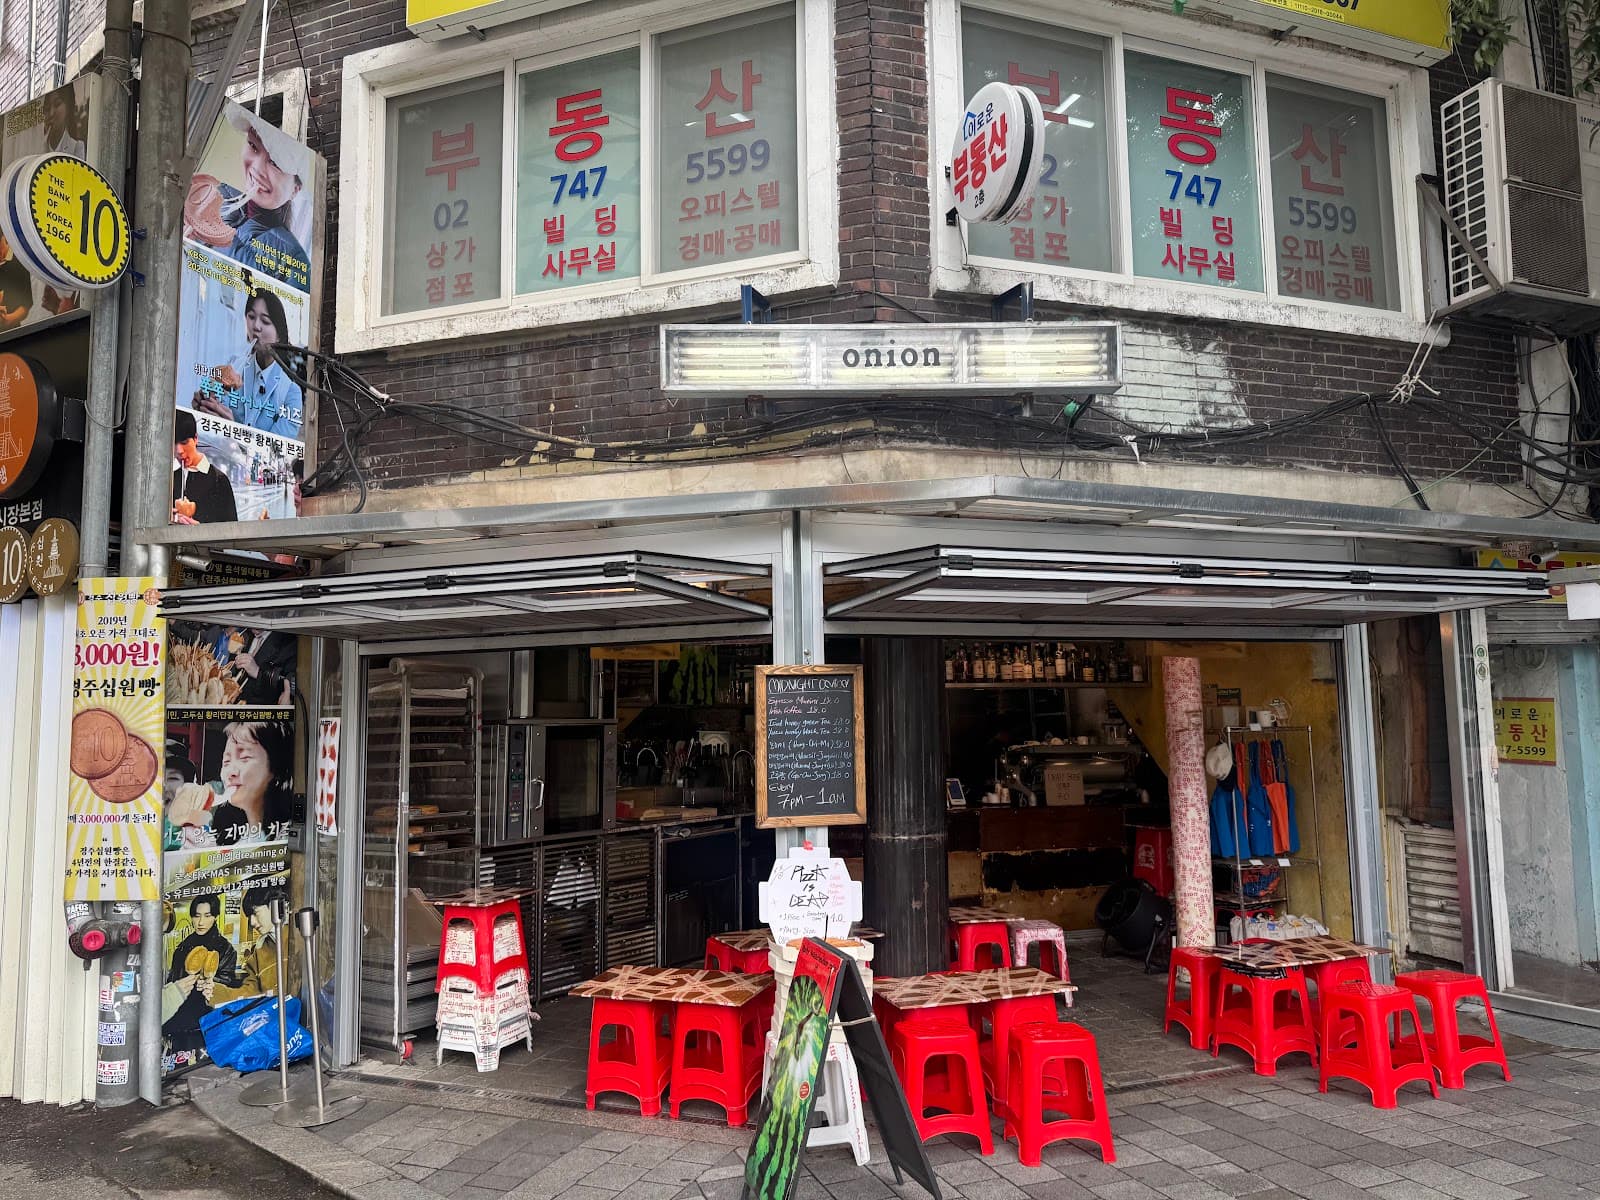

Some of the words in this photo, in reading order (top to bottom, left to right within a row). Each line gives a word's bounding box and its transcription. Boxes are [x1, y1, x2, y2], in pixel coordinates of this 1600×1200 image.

[425, 121, 480, 191] 부
[549, 88, 609, 162] 동
[695, 60, 761, 137] 산
[968, 102, 994, 137] 이로운
[1160, 87, 1221, 166] 동
[1290, 124, 1347, 197] 산
[953, 112, 1008, 202] 부동산
[48, 174, 65, 189] THE
[433, 200, 468, 230] 02
[550, 166, 607, 206] 747
[686, 139, 770, 184] 5599
[47, 198, 58, 208] OF
[48, 186, 71, 203] BANK
[974, 189, 985, 208] 2층
[1165, 169, 1221, 207] 747
[1289, 197, 1357, 234] 5599
[46, 210, 73, 229] KOREA
[80, 190, 120, 267] 10
[426, 237, 475, 269] 상가
[679, 180, 780, 222] 오피스텔
[46, 224, 71, 243] 1966
[1010, 226, 1070, 260] 점포
[1161, 243, 1235, 280] 사무실
[1280, 235, 1370, 273] 오피스텔
[425, 272, 474, 305] 점포
[542, 242, 616, 279] 사무실
[842, 339, 942, 368] onion
[279, 405, 304, 426] 치즈
[201, 417, 252, 444] 경주십원빵
[287, 442, 304, 460] 본점
[2, 539, 23, 586] 10
[98, 616, 127, 626] 2019년
[76, 629, 87, 638] 초
[89, 628, 106, 638] 오픈
[108, 628, 127, 638] 가격
[129, 628, 159, 638] 그대로
[74, 641, 160, 670] 3,000원!
[181, 711, 204, 720] 고두심
[277, 711, 290, 720] 방문
[1494, 707, 1539, 721] 이로운
[68, 814, 77, 824] 매
[78, 814, 129, 824] 3,000,000개
[132, 813, 156, 824] 돌파!
[224, 821, 263, 840] 지민의
[80, 847, 130, 856] 경주십원빵은
[235, 848, 277, 861] dreaming
[278, 846, 288, 856] of
[75, 869, 100, 878] 가격을
[102, 868, 156, 878] 지키겠습니다.
[234, 866, 242, 875] in
[245, 861, 285, 874] 경주십원빵
[791, 864, 829, 882] PIZZA
[270, 876, 287, 887] 방송
[789, 891, 829, 909] DEAD
